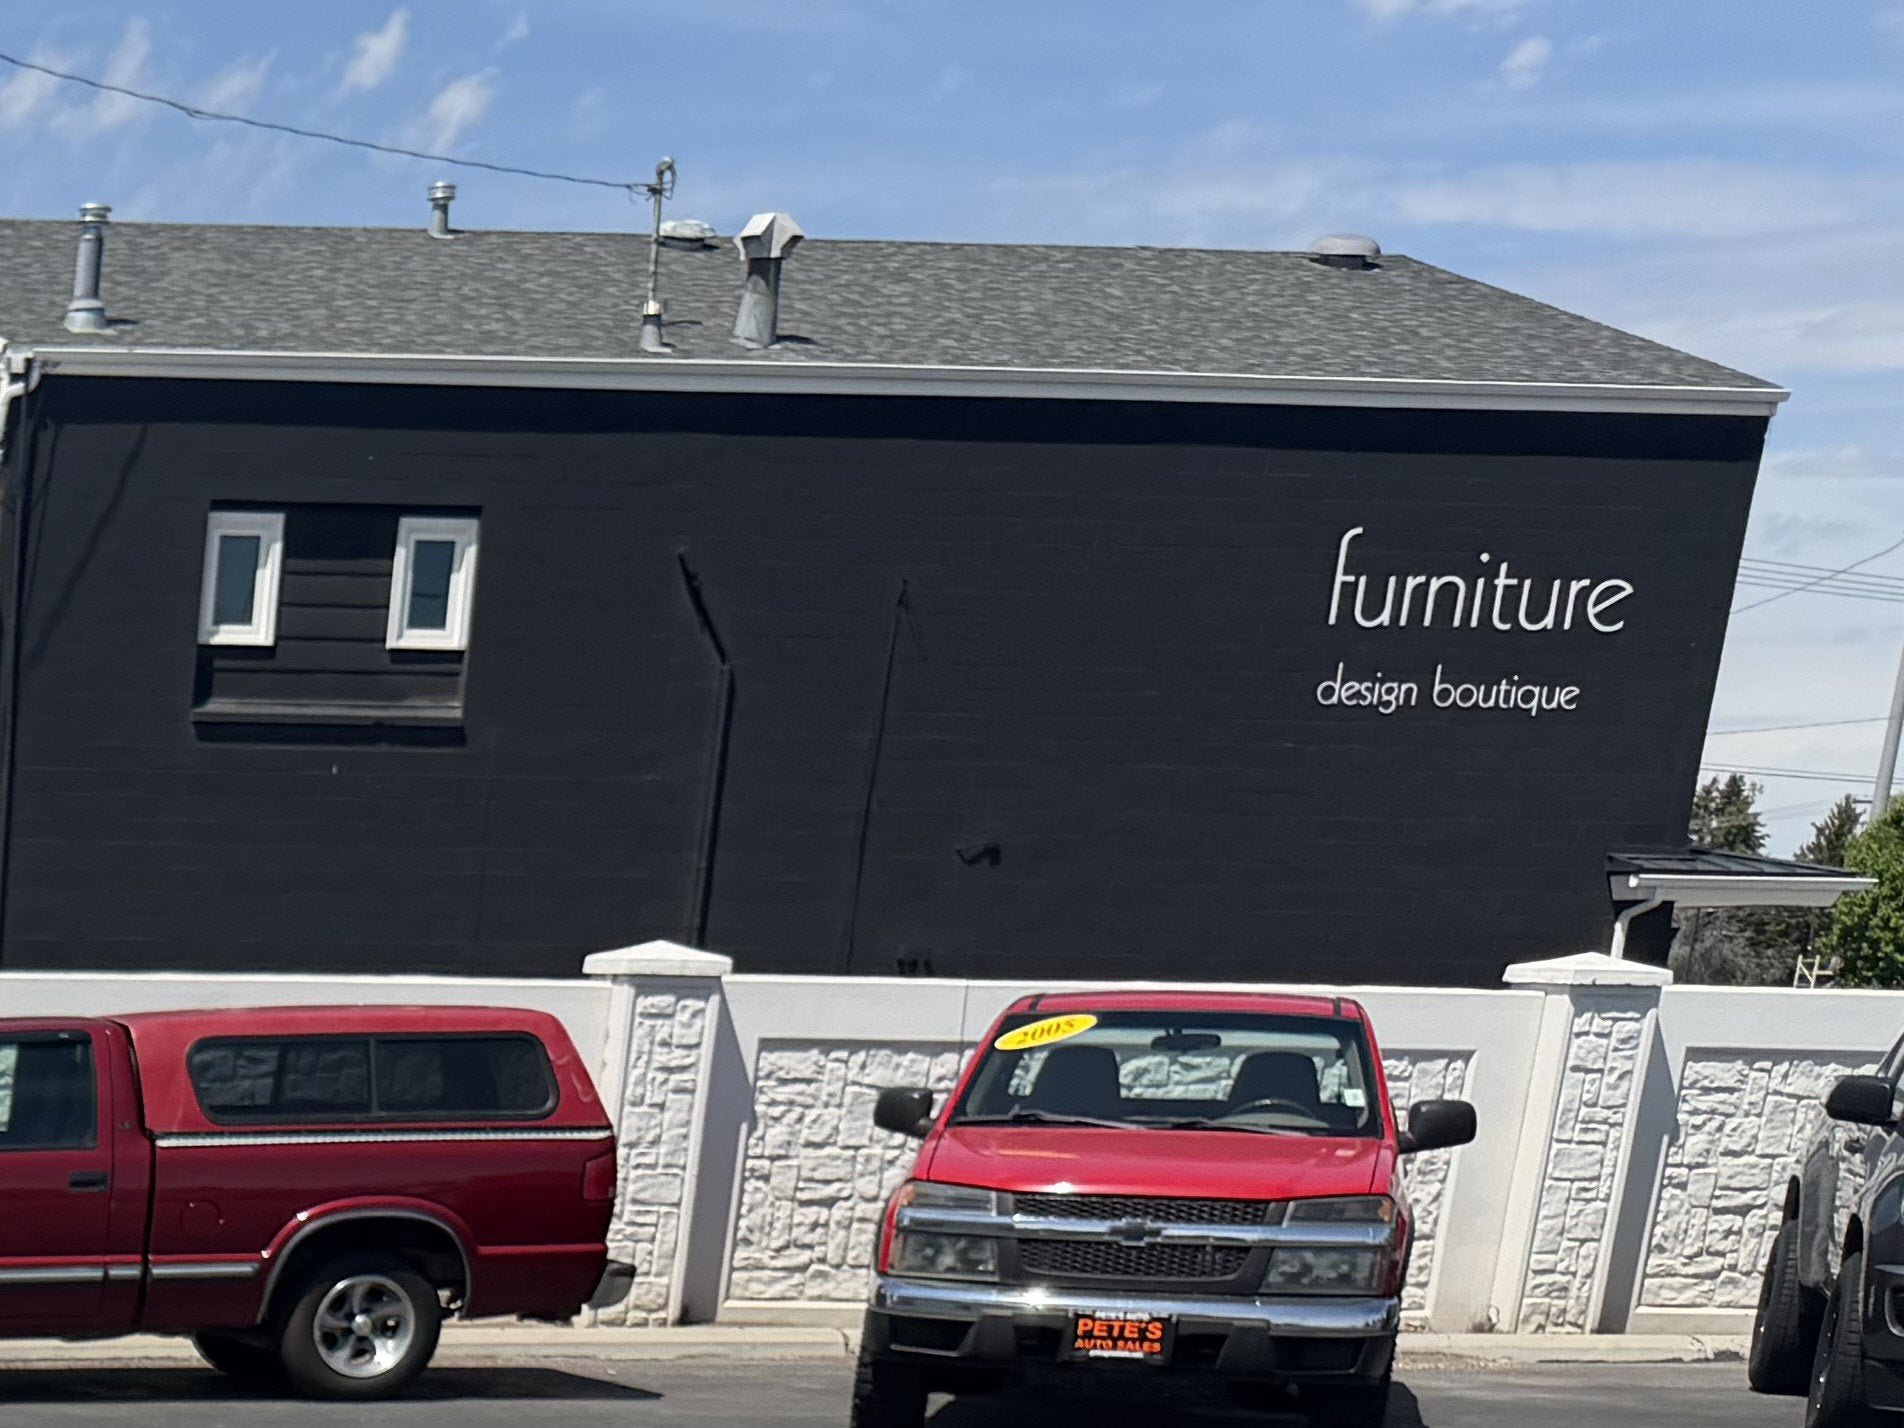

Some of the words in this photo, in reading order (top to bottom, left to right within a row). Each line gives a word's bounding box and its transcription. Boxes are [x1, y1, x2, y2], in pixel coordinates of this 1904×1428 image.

[1328, 526, 1634, 633] furniture
[1316, 661, 1418, 714] design
[1432, 663, 1580, 717] boutique
[1074, 1338, 1113, 1351] AUTO
[1116, 1340, 1161, 1352] SALES
[1077, 1318, 1162, 1339] PETE'S
